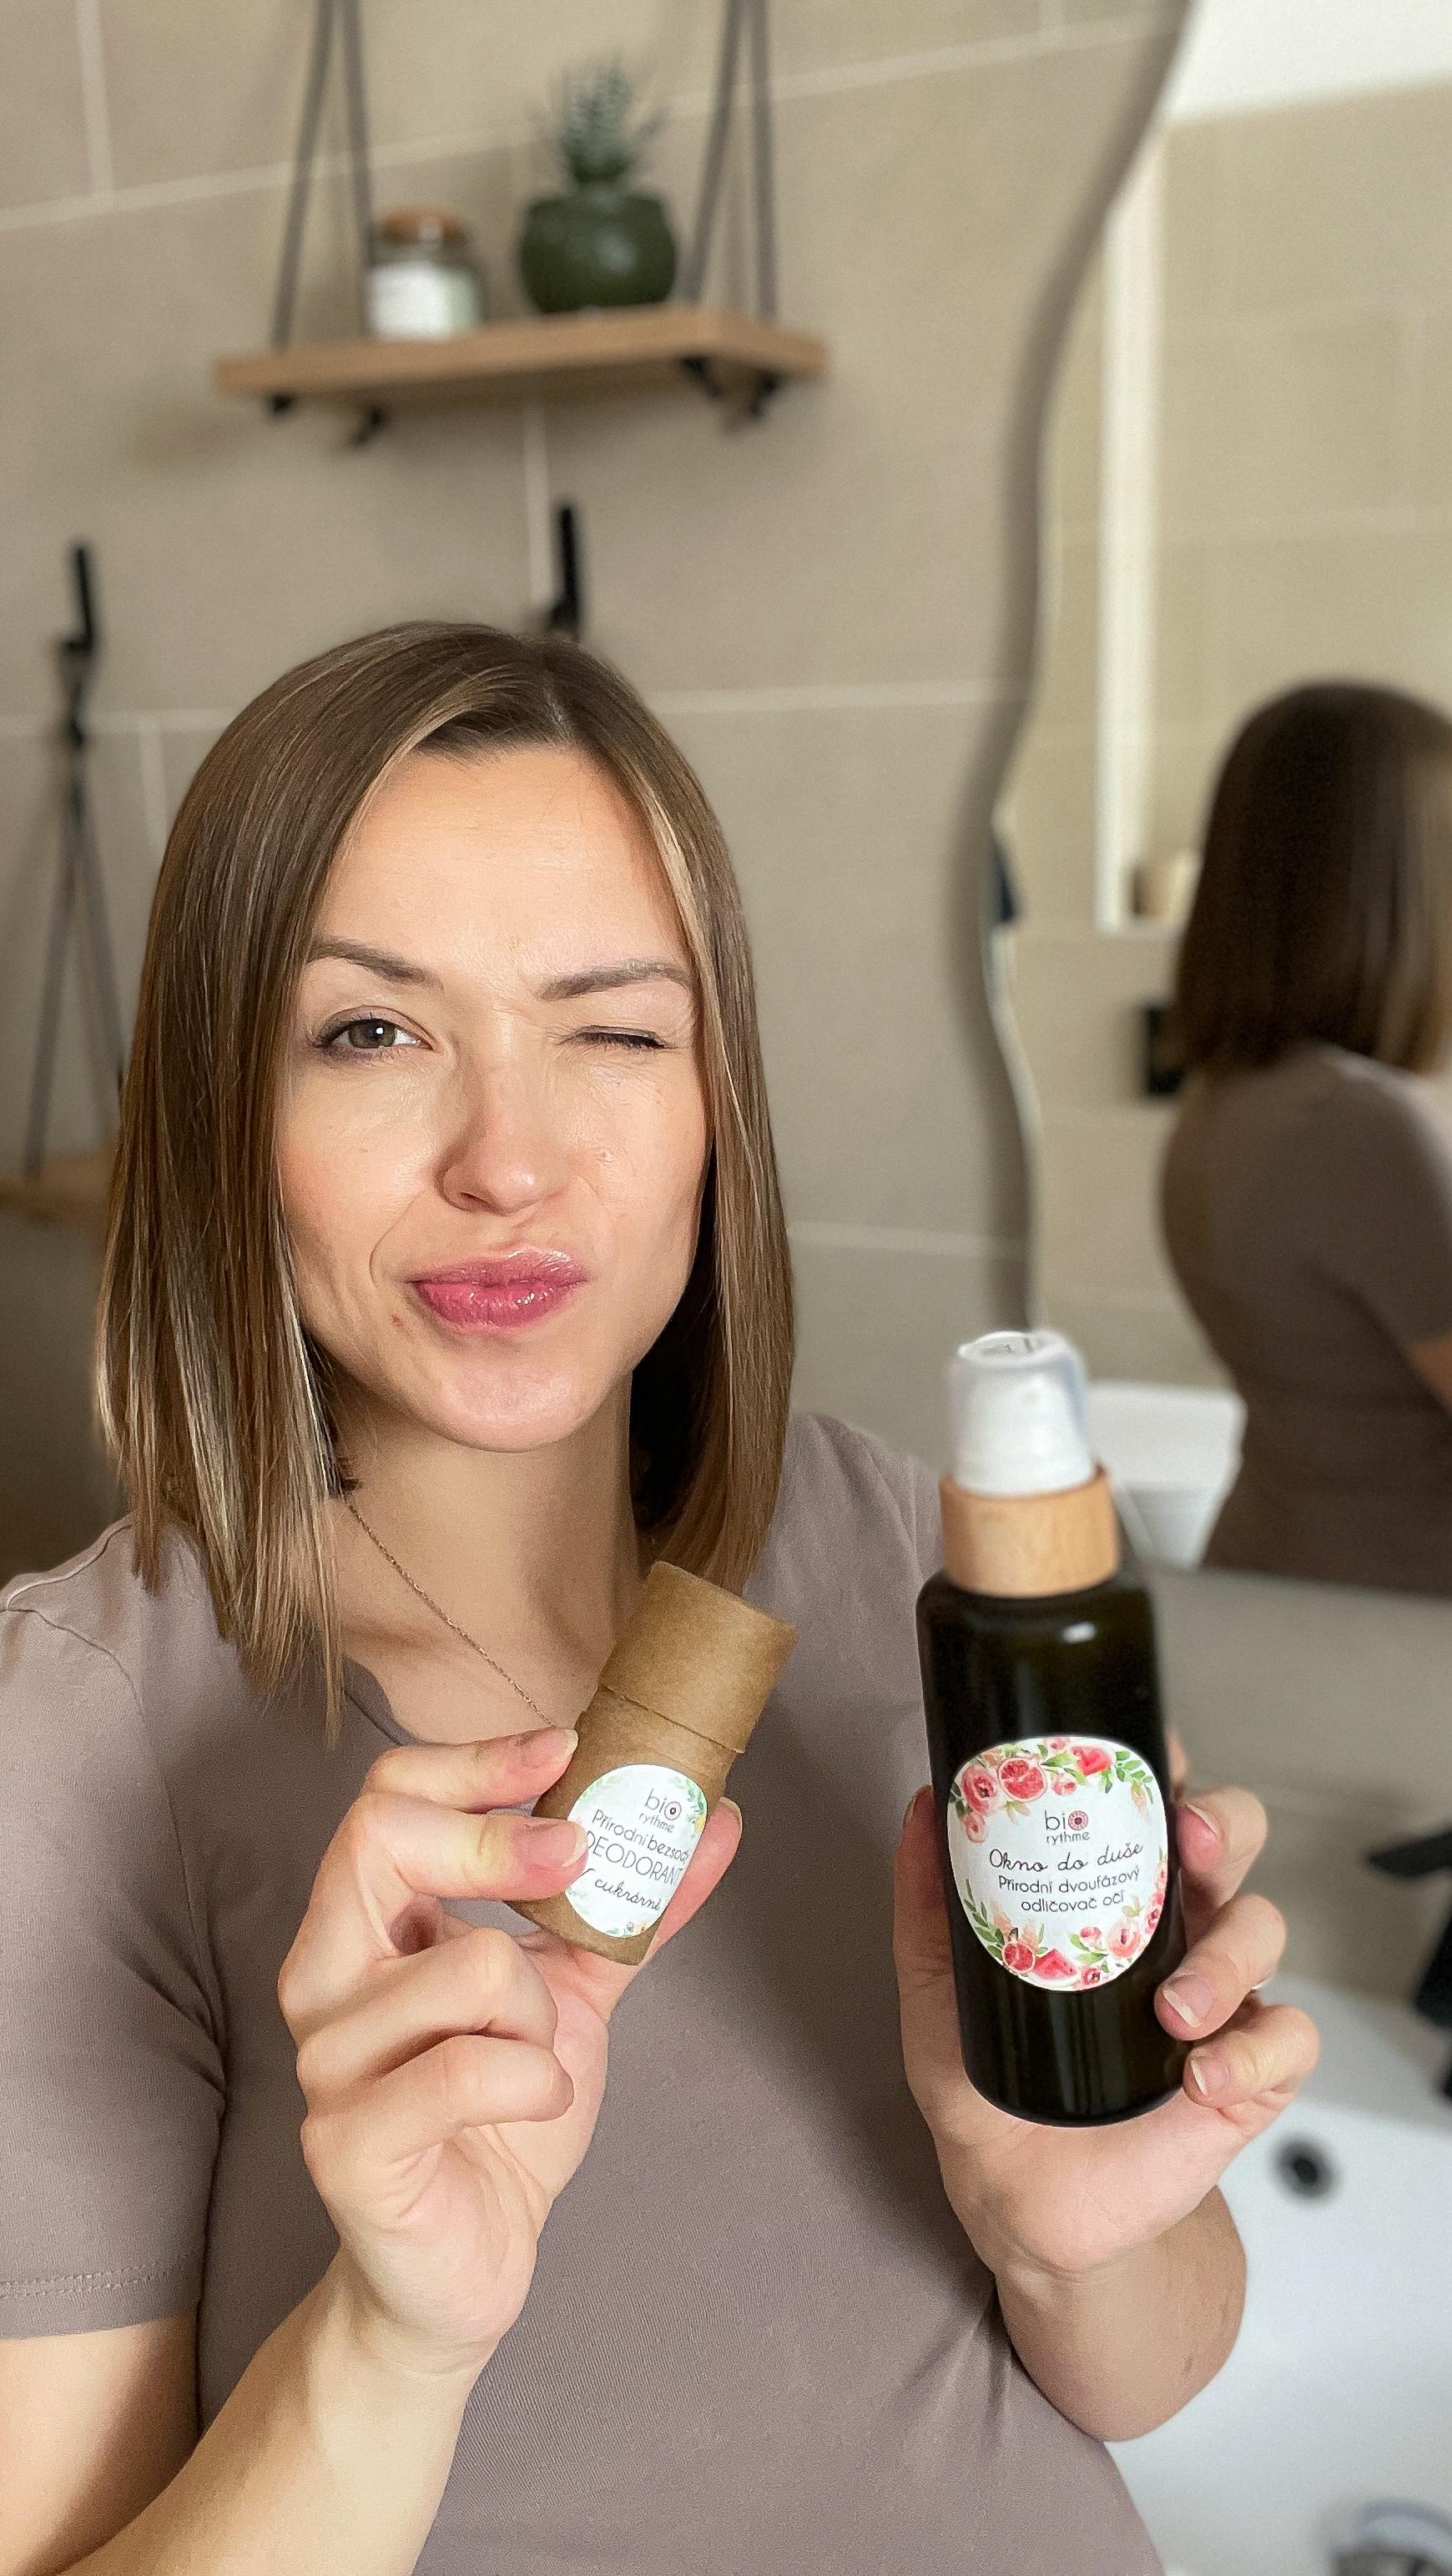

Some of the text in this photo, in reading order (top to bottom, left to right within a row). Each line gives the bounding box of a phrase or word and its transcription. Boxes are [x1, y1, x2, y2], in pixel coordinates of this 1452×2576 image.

[638, 1813, 675, 1834] rythme
[1045, 1809, 1089, 1831] bio
[1046, 1831, 1091, 1846] rythme
[989, 1841, 1144, 1872] Okno do duše
[1058, 1865, 1140, 1894] dvoufázový
[1021, 1896, 1098, 1913] odličovač
